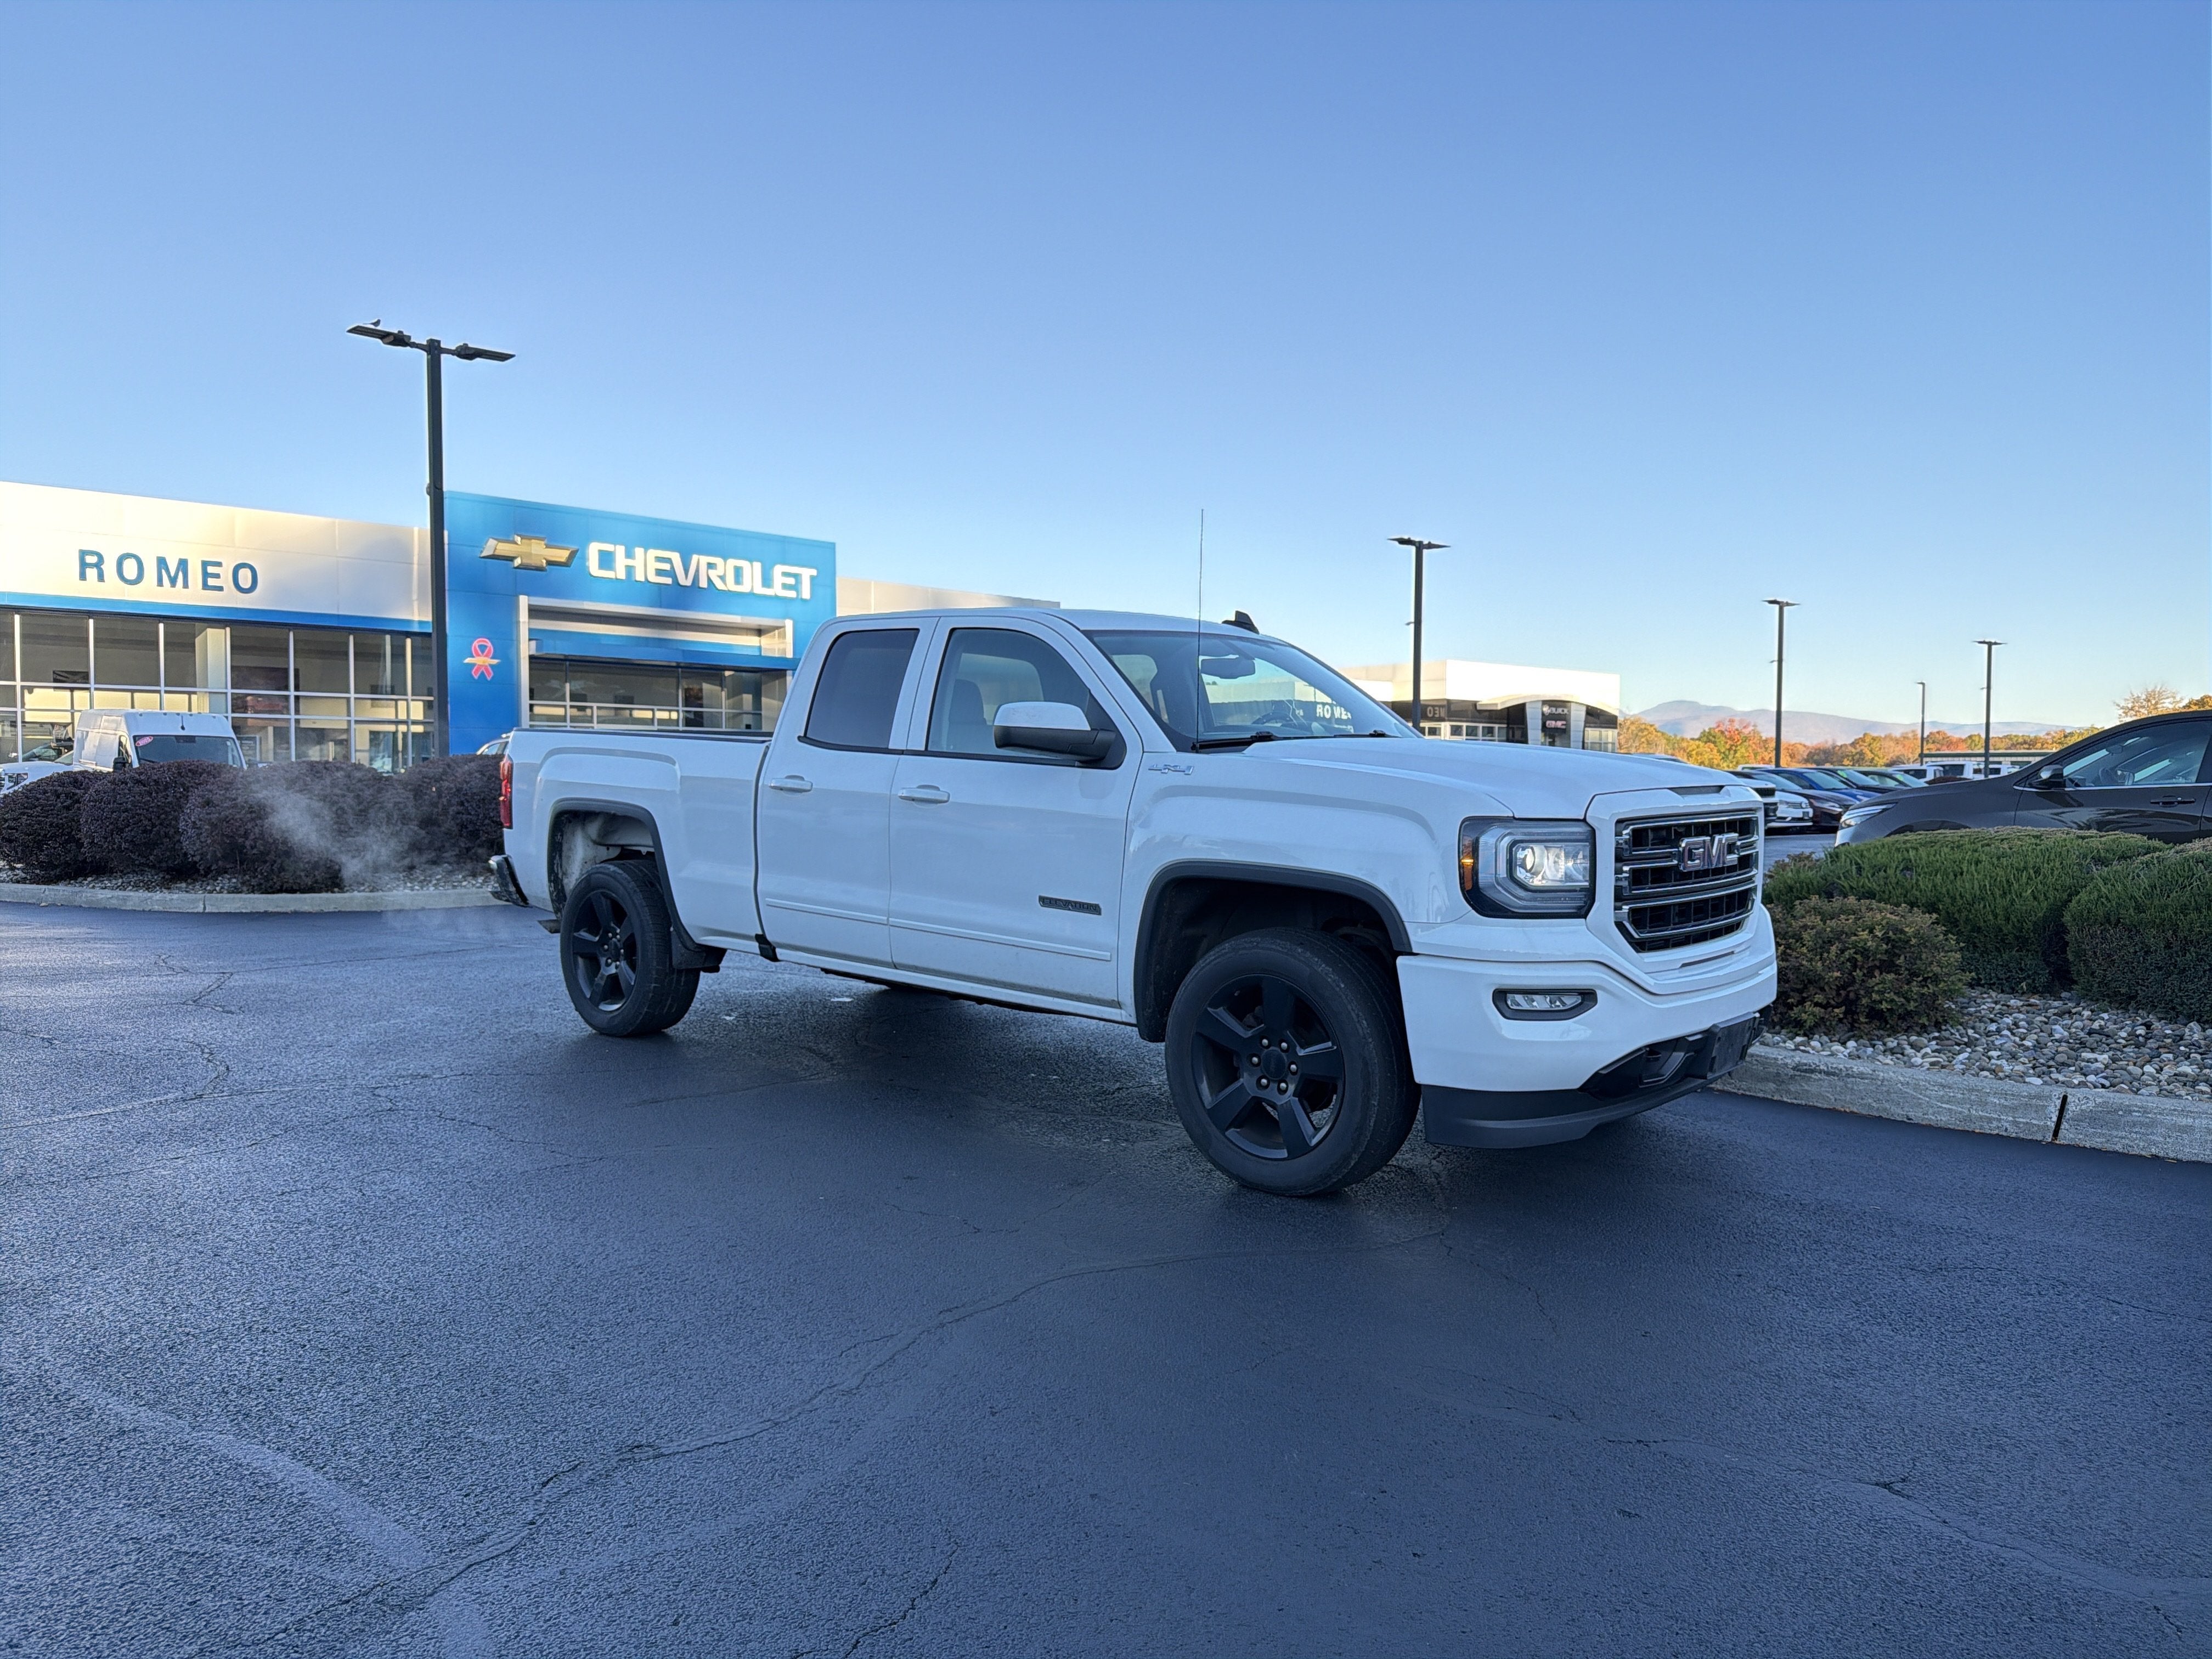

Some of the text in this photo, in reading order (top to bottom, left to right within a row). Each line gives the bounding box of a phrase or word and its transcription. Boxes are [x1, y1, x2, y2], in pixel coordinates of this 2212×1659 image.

[78, 549, 258, 594] ROMEO
[588, 542, 817, 600] CHEVROLET
[1546, 720, 1566, 729] GMC
[1679, 832, 1739, 872] GMC
[1043, 899, 1097, 911] ELEVATION
